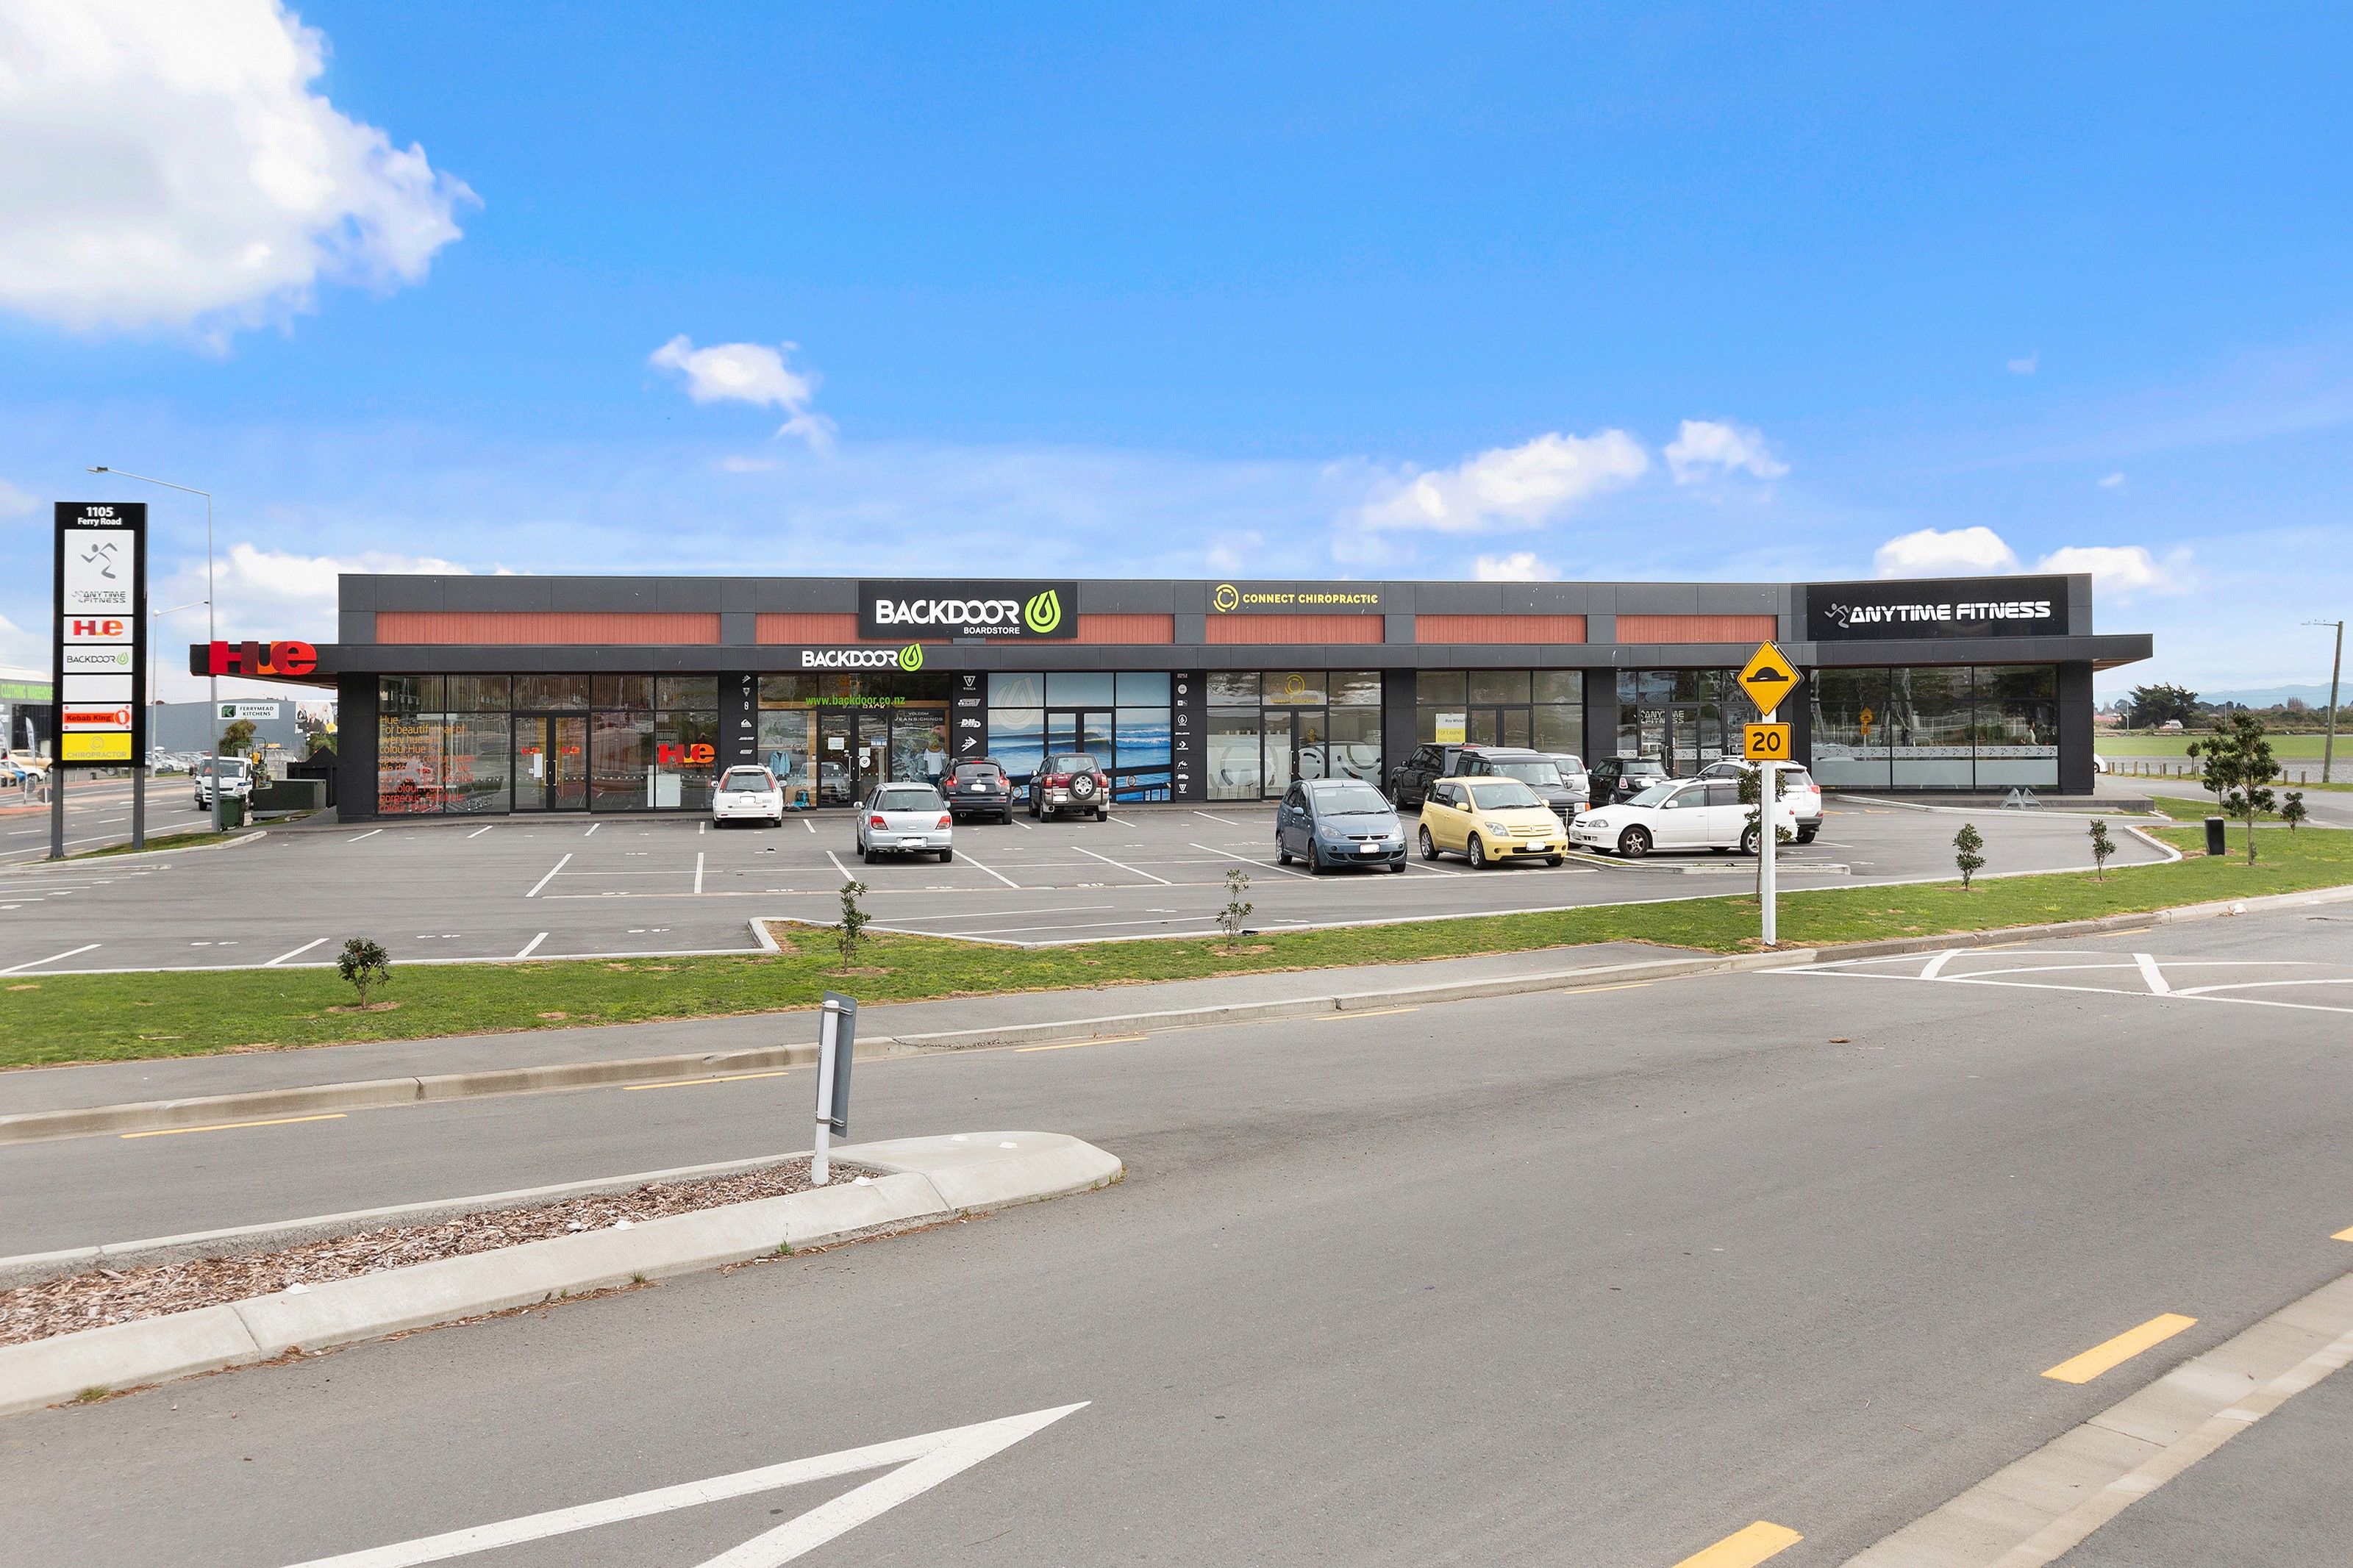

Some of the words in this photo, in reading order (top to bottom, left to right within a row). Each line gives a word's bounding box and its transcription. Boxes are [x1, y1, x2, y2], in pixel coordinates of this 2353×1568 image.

[86, 506, 113, 517] 1105
[77, 518, 99, 526] Ferry
[1242, 594, 1295, 604] CONNECT
[1298, 593, 1378, 604] CHIROPRACTIC
[876, 599, 1020, 624] BACKDOOR
[1849, 604, 1951, 623] ANYTIME
[1956, 601, 2051, 620] FITNESS
[67, 655, 115, 663] BACKDOOR
[801, 650, 899, 667] BACKDOOR
[805, 694, 905, 706] www.backdoor.co.nz
[93, 714, 111, 723] King
[1753, 731, 1781, 752] 20
